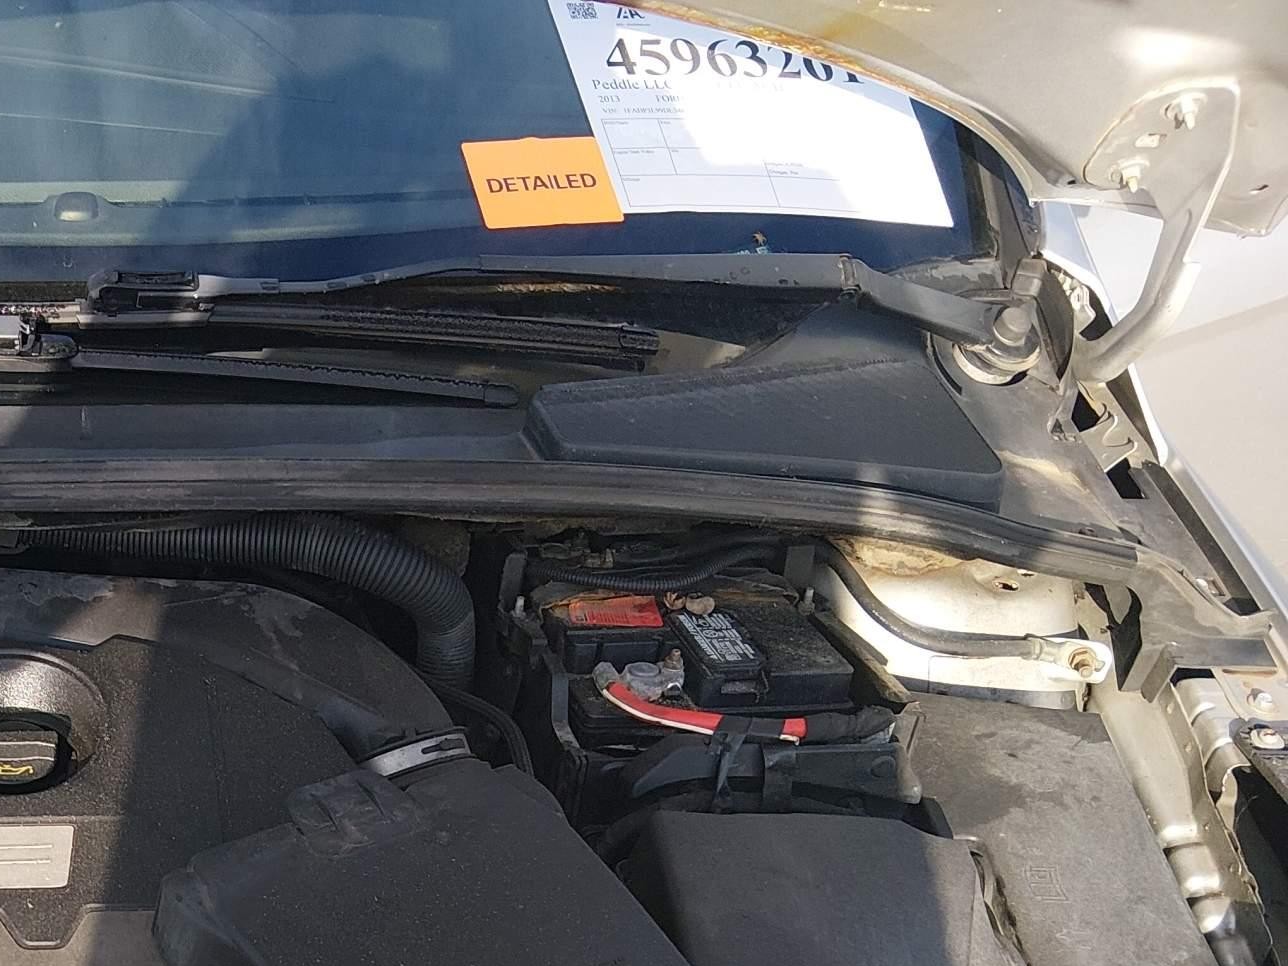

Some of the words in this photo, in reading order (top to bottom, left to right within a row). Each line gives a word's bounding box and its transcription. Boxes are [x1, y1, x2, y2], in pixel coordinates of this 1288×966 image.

[591, 79, 640, 90] Peddle
[598, 95, 621, 103] 2013
[486, 173, 597, 193] DETAILED
